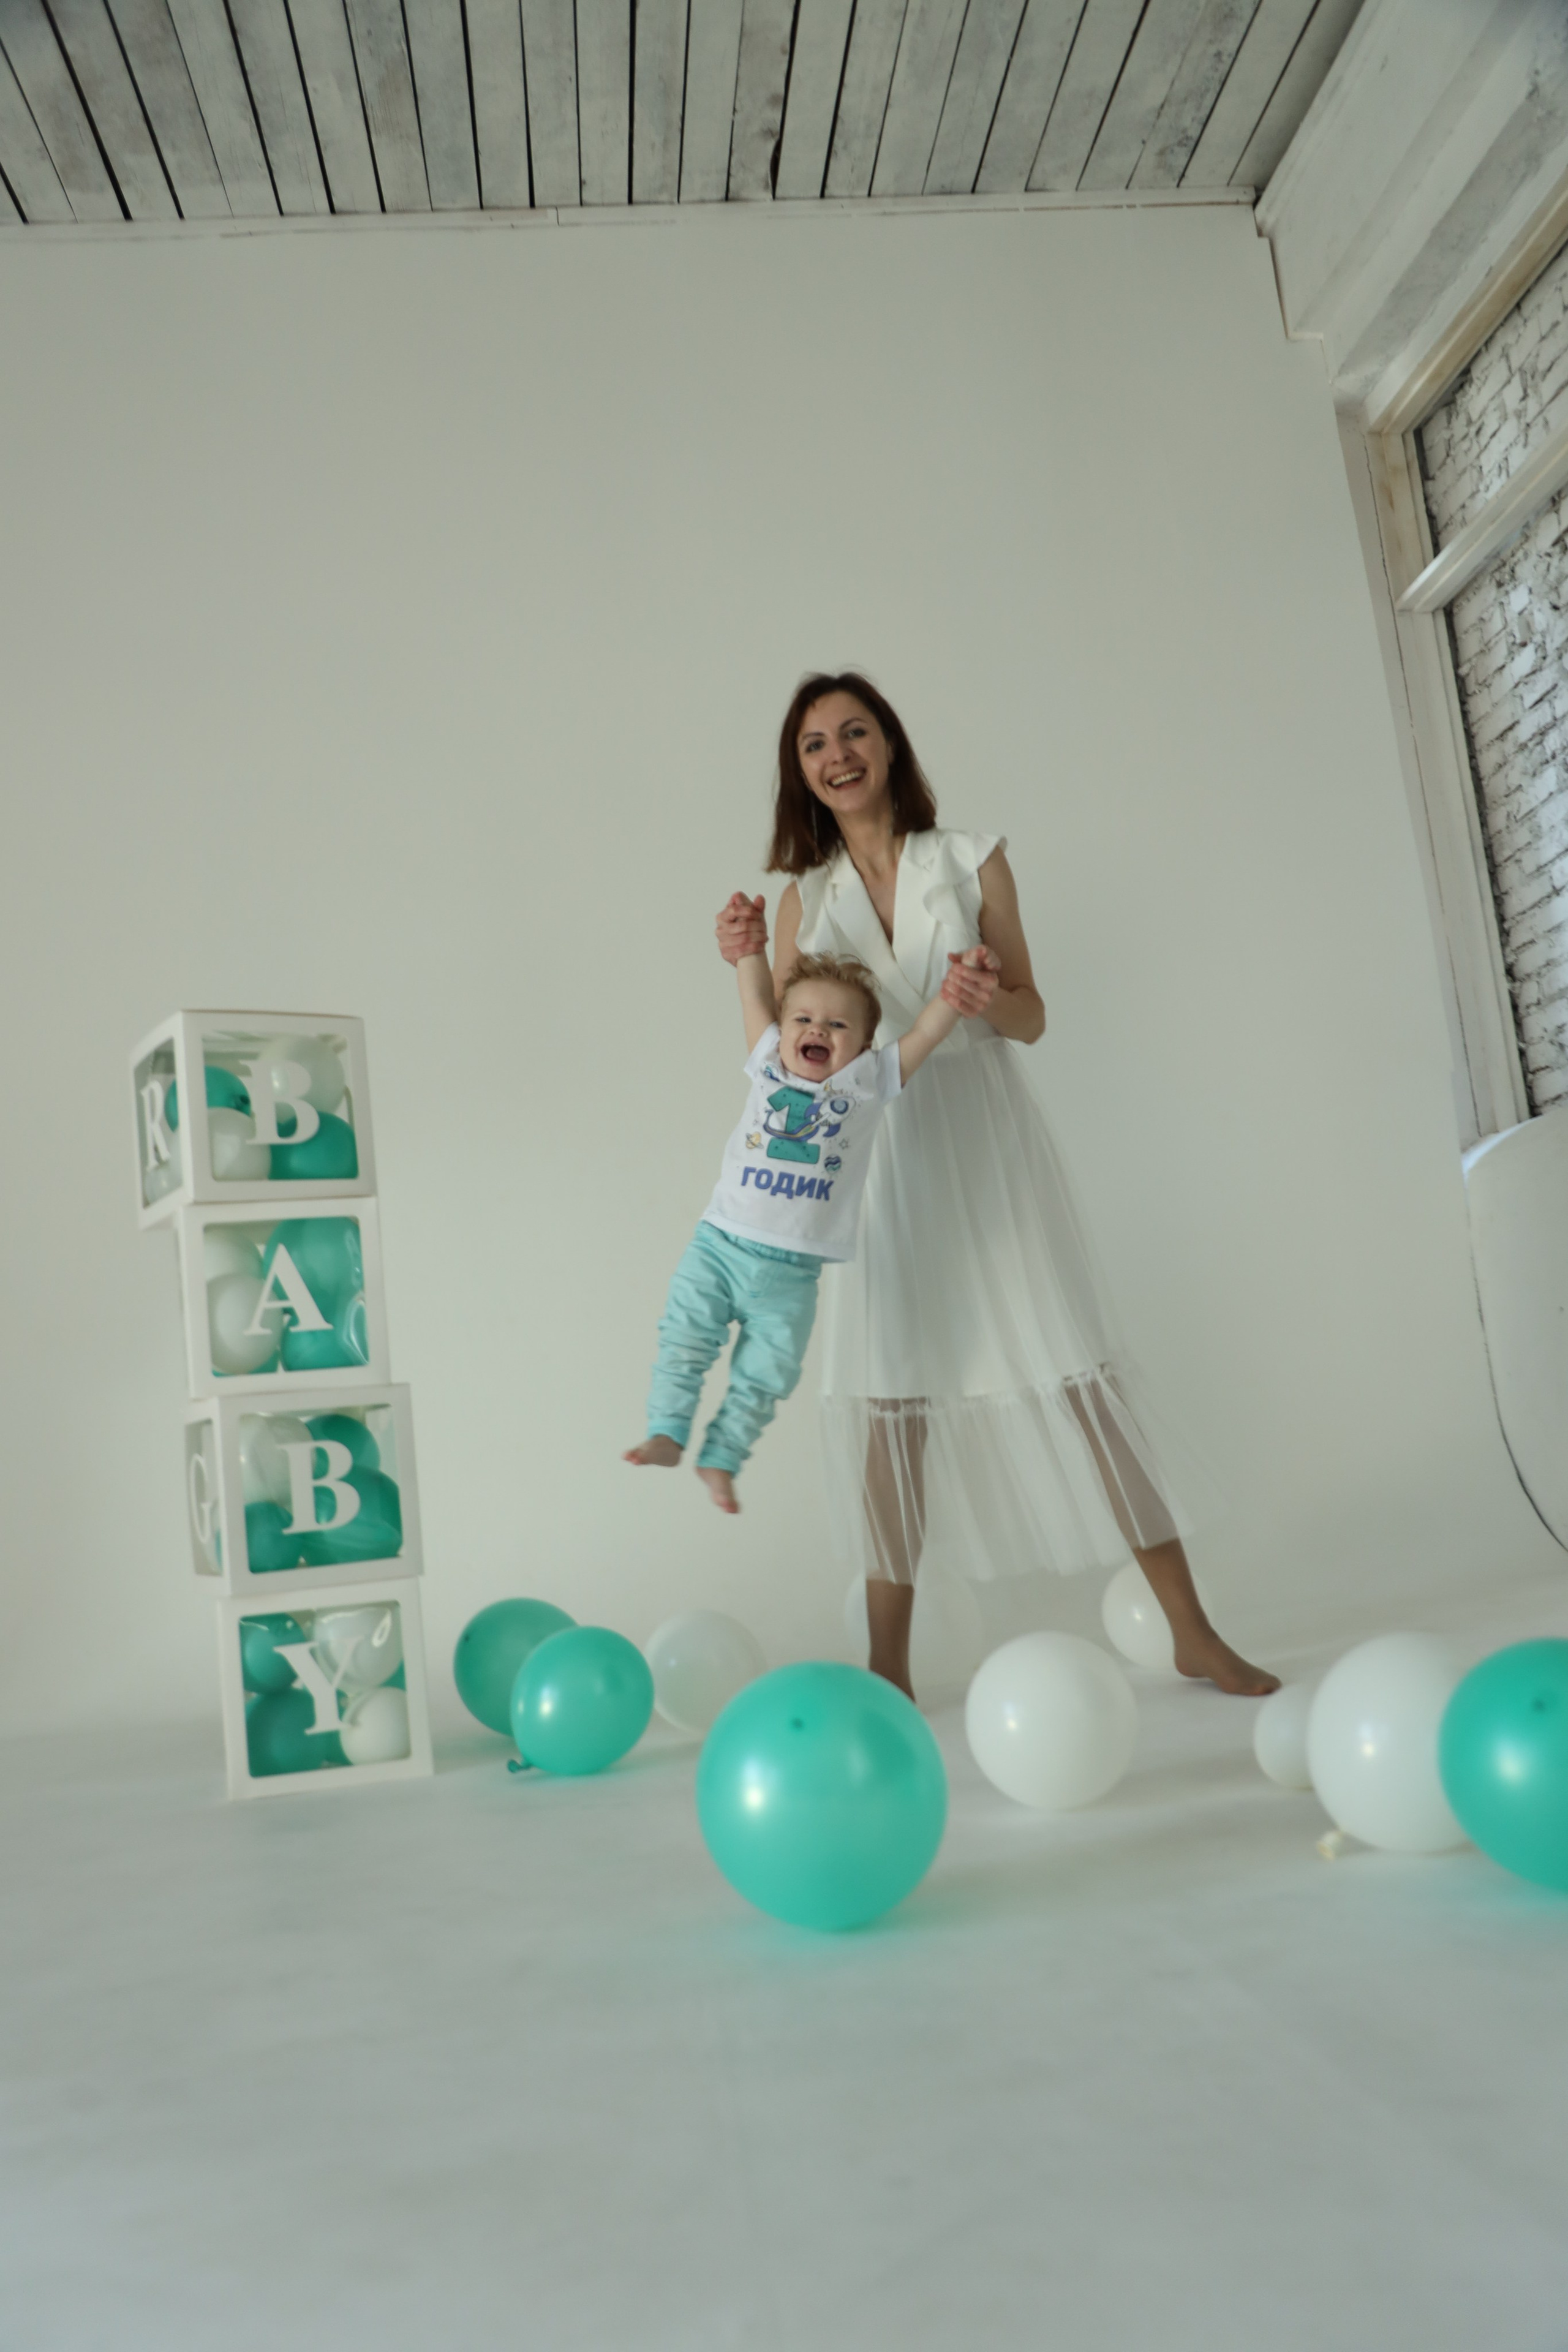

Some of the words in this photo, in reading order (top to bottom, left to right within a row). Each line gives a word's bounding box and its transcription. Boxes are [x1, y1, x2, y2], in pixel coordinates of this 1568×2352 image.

[239, 1058, 320, 1145] B
[767, 1086, 821, 1164] 1
[741, 1166, 835, 1202] ГОДИК
[244, 1243, 334, 1336] A
[276, 1439, 361, 1535] B
[273, 1634, 365, 1736] Y
